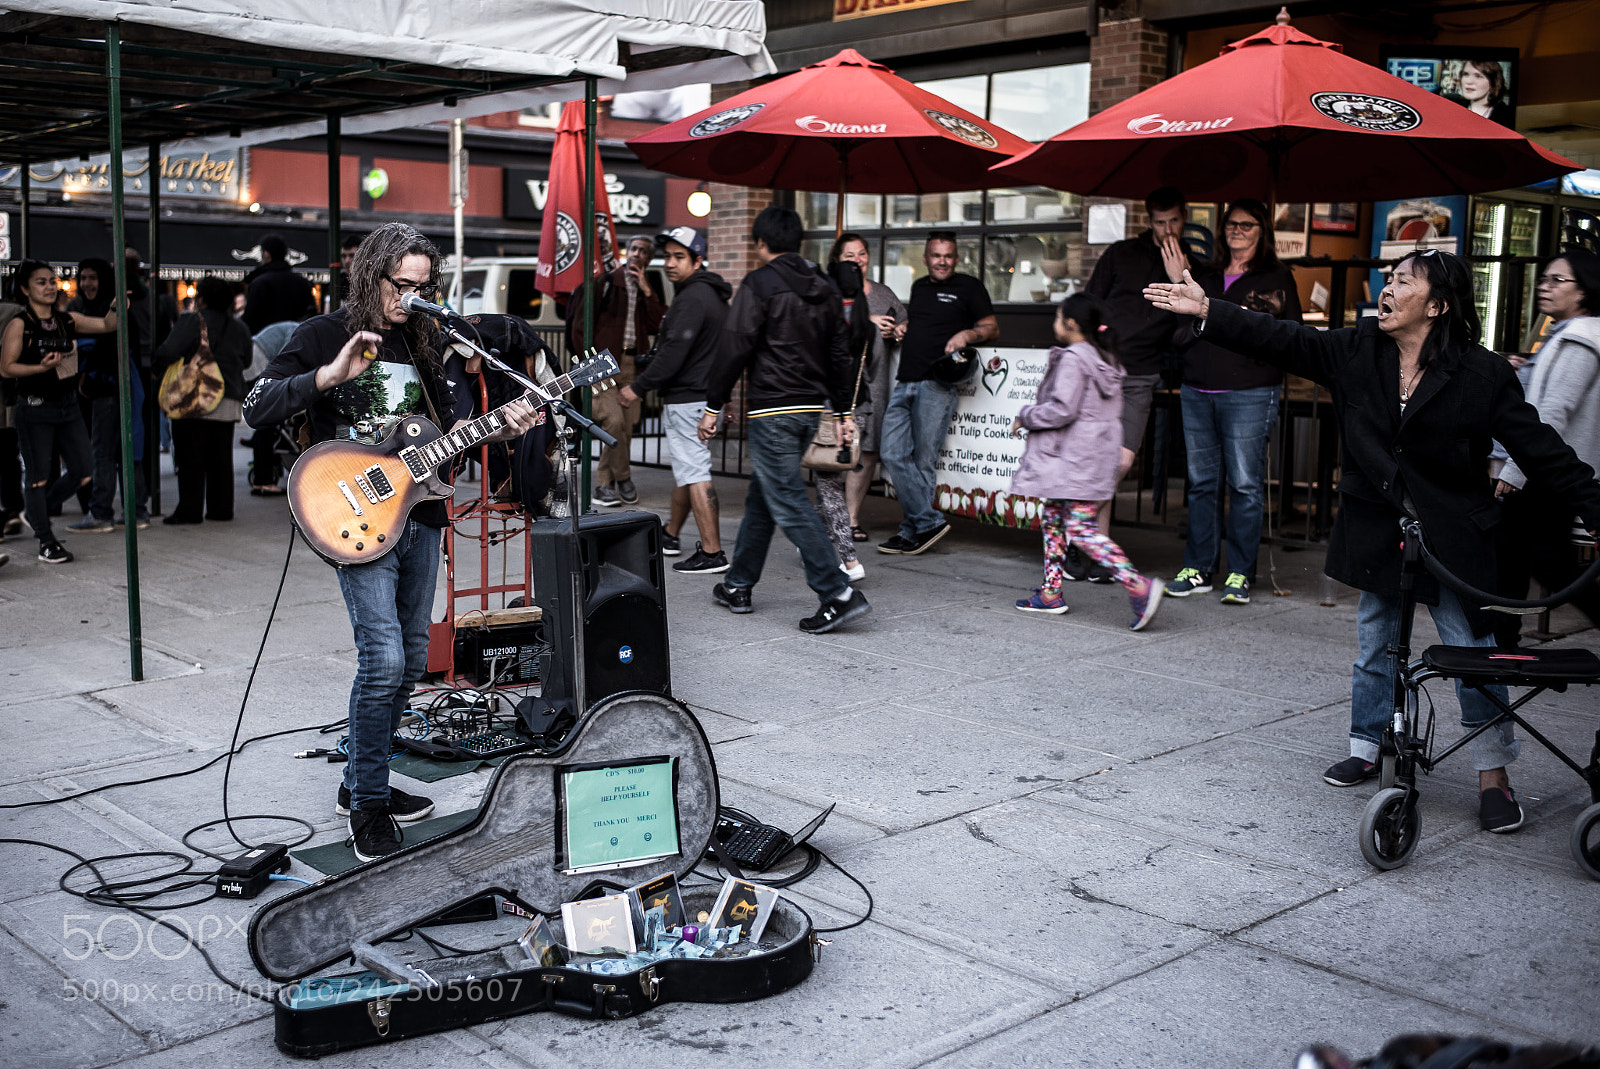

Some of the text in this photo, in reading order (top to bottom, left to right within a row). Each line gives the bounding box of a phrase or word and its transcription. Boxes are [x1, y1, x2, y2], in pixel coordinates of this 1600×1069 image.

[1351, 95, 1409, 114] MARKET
[795, 114, 887, 134] Ottawa
[1127, 113, 1234, 135] Ottawa
[63, 174, 227, 195] RESARANT
[556, 216, 578, 245] ARKET
[1274, 239, 1304, 254] OUNTRY
[952, 412, 1011, 426] ByWard Tulip
[959, 426, 981, 439] Tulip
[983, 429, 1014, 440] Cookie
[938, 449, 953, 458] arc
[956, 449, 983, 461] Tulipe
[986, 453, 998, 462] du
[948, 463, 978, 474] officiel
[981, 465, 993, 476] de
[483, 646, 517, 657] UB121000
[619, 649, 632, 659] RCF
[614, 784, 637, 793] PLEASE
[601, 790, 651, 803] HELP YOURSELF
[593, 813, 657, 828] THANK YOU MERCI
[221, 881, 243, 895] cry baby
